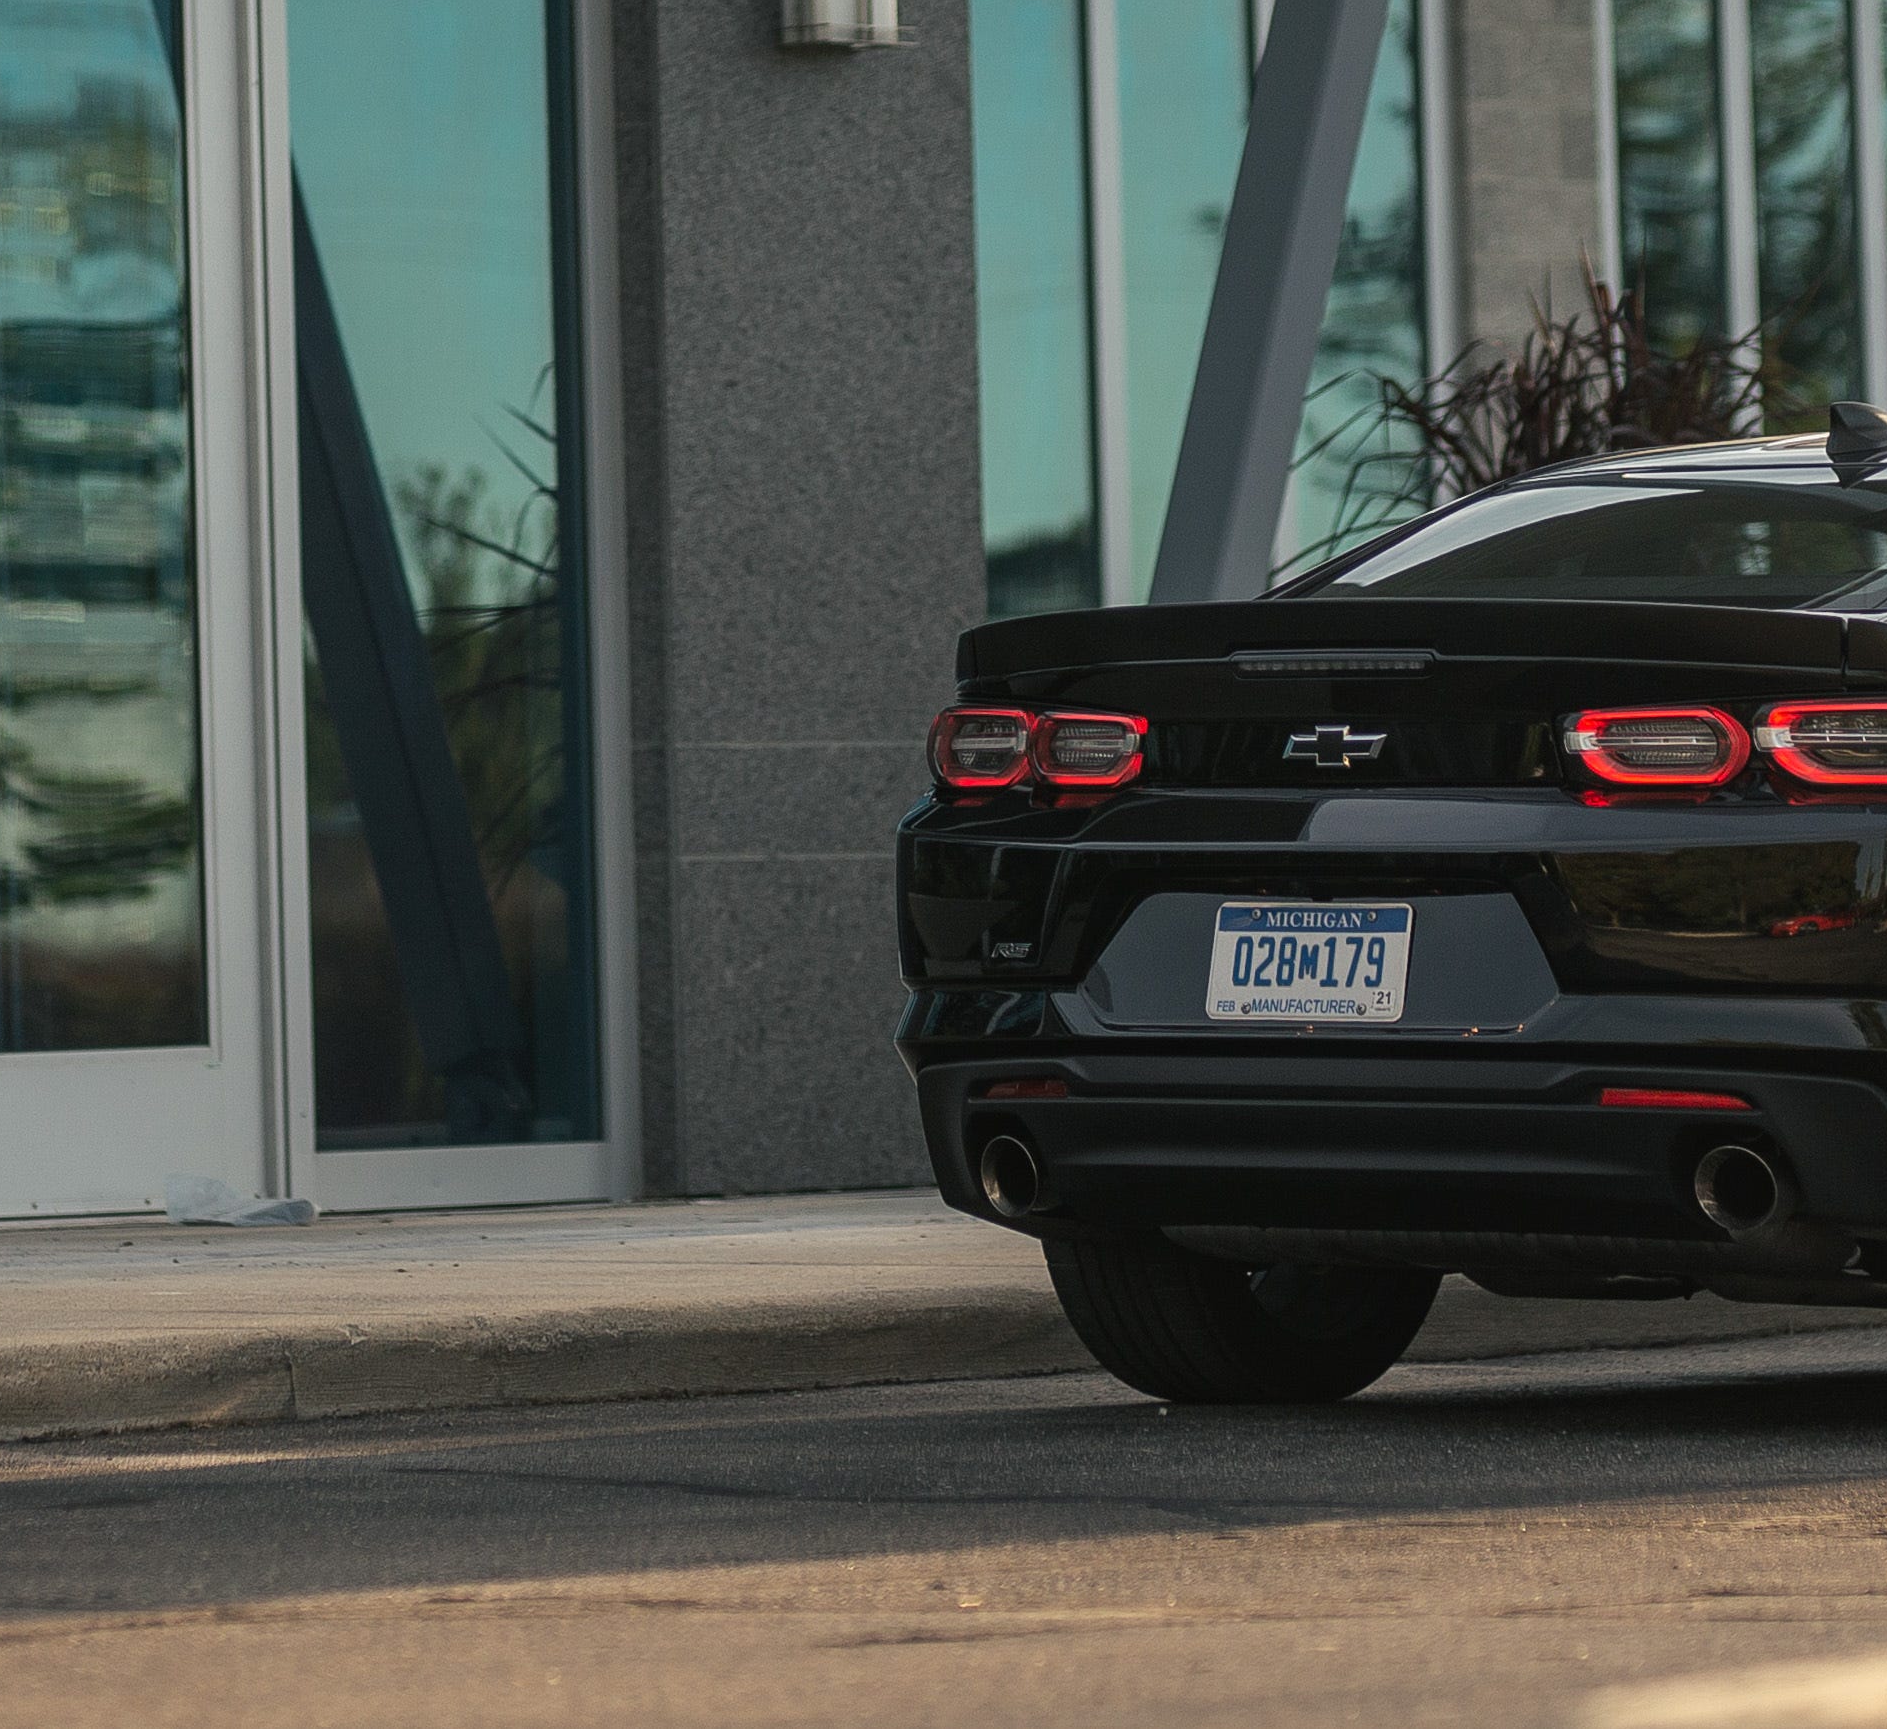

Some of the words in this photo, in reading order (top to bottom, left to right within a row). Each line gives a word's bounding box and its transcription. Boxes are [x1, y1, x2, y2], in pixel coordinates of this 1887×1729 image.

[1266, 912, 1363, 929] MICHIGAN
[1232, 936, 1385, 988] 028M179
[1216, 999, 1236, 1012] FEB
[1251, 998, 1356, 1015] MANUFACTURER
